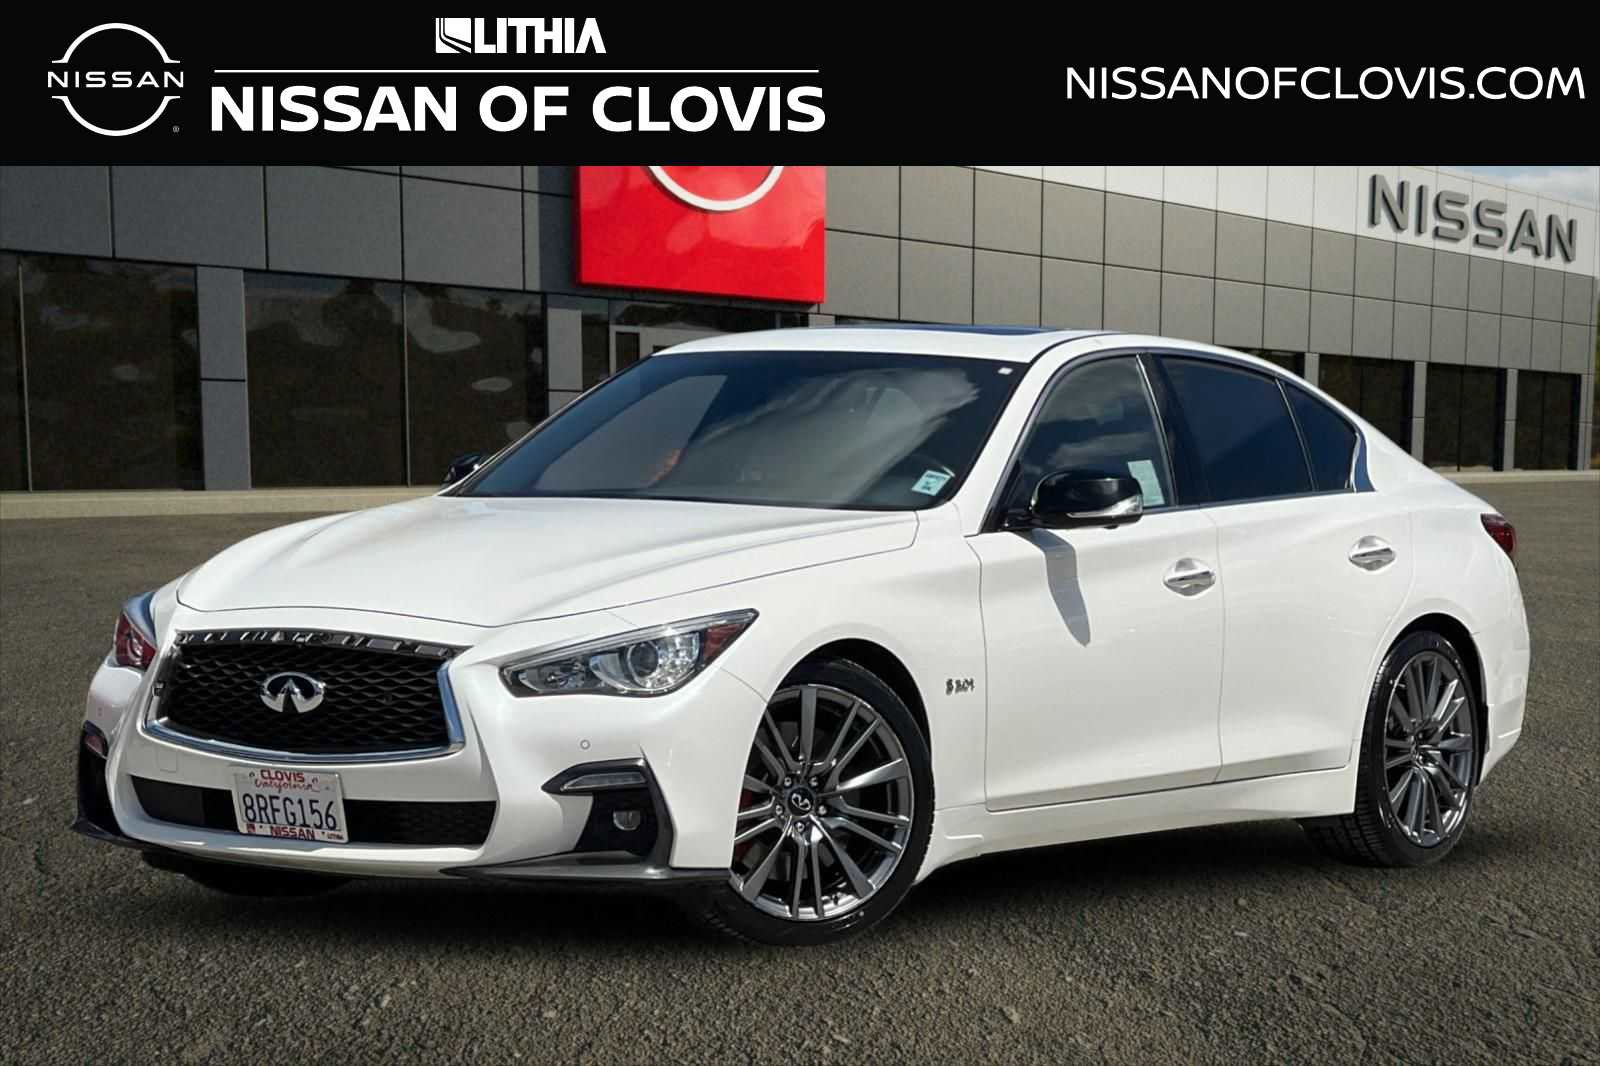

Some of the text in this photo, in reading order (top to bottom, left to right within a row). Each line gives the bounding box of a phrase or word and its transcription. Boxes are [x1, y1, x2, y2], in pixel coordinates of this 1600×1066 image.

[1368, 173, 1578, 263] NISSAN
[260, 769, 305, 783] CLOVIS
[242, 793, 337, 831] 8RFG156
[270, 825, 315, 841] NISSAN
